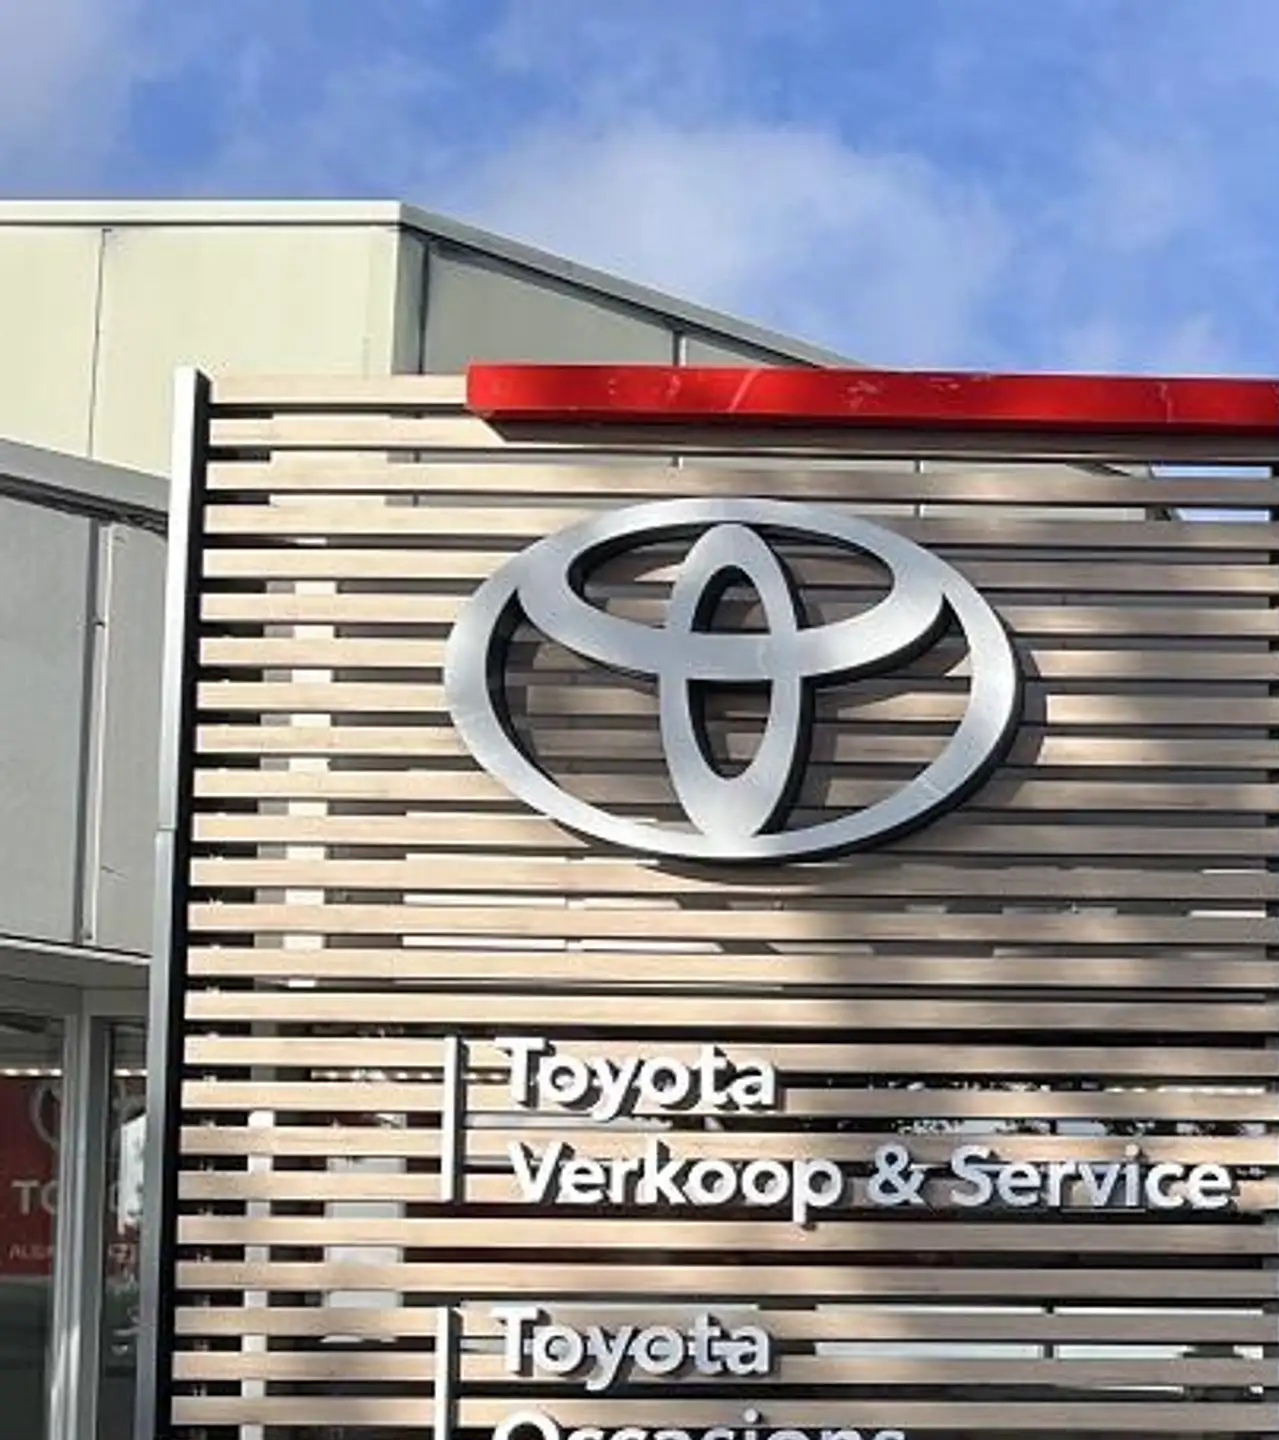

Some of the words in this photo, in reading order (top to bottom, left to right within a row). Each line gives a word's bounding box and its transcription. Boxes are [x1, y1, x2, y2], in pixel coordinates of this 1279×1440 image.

[494, 1036, 776, 1122] Toyota
[507, 1134, 843, 1223] Verkoop
[868, 1143, 925, 1206] &
[950, 1143, 1233, 1209] Service
[489, 1306, 770, 1391] Toyota
